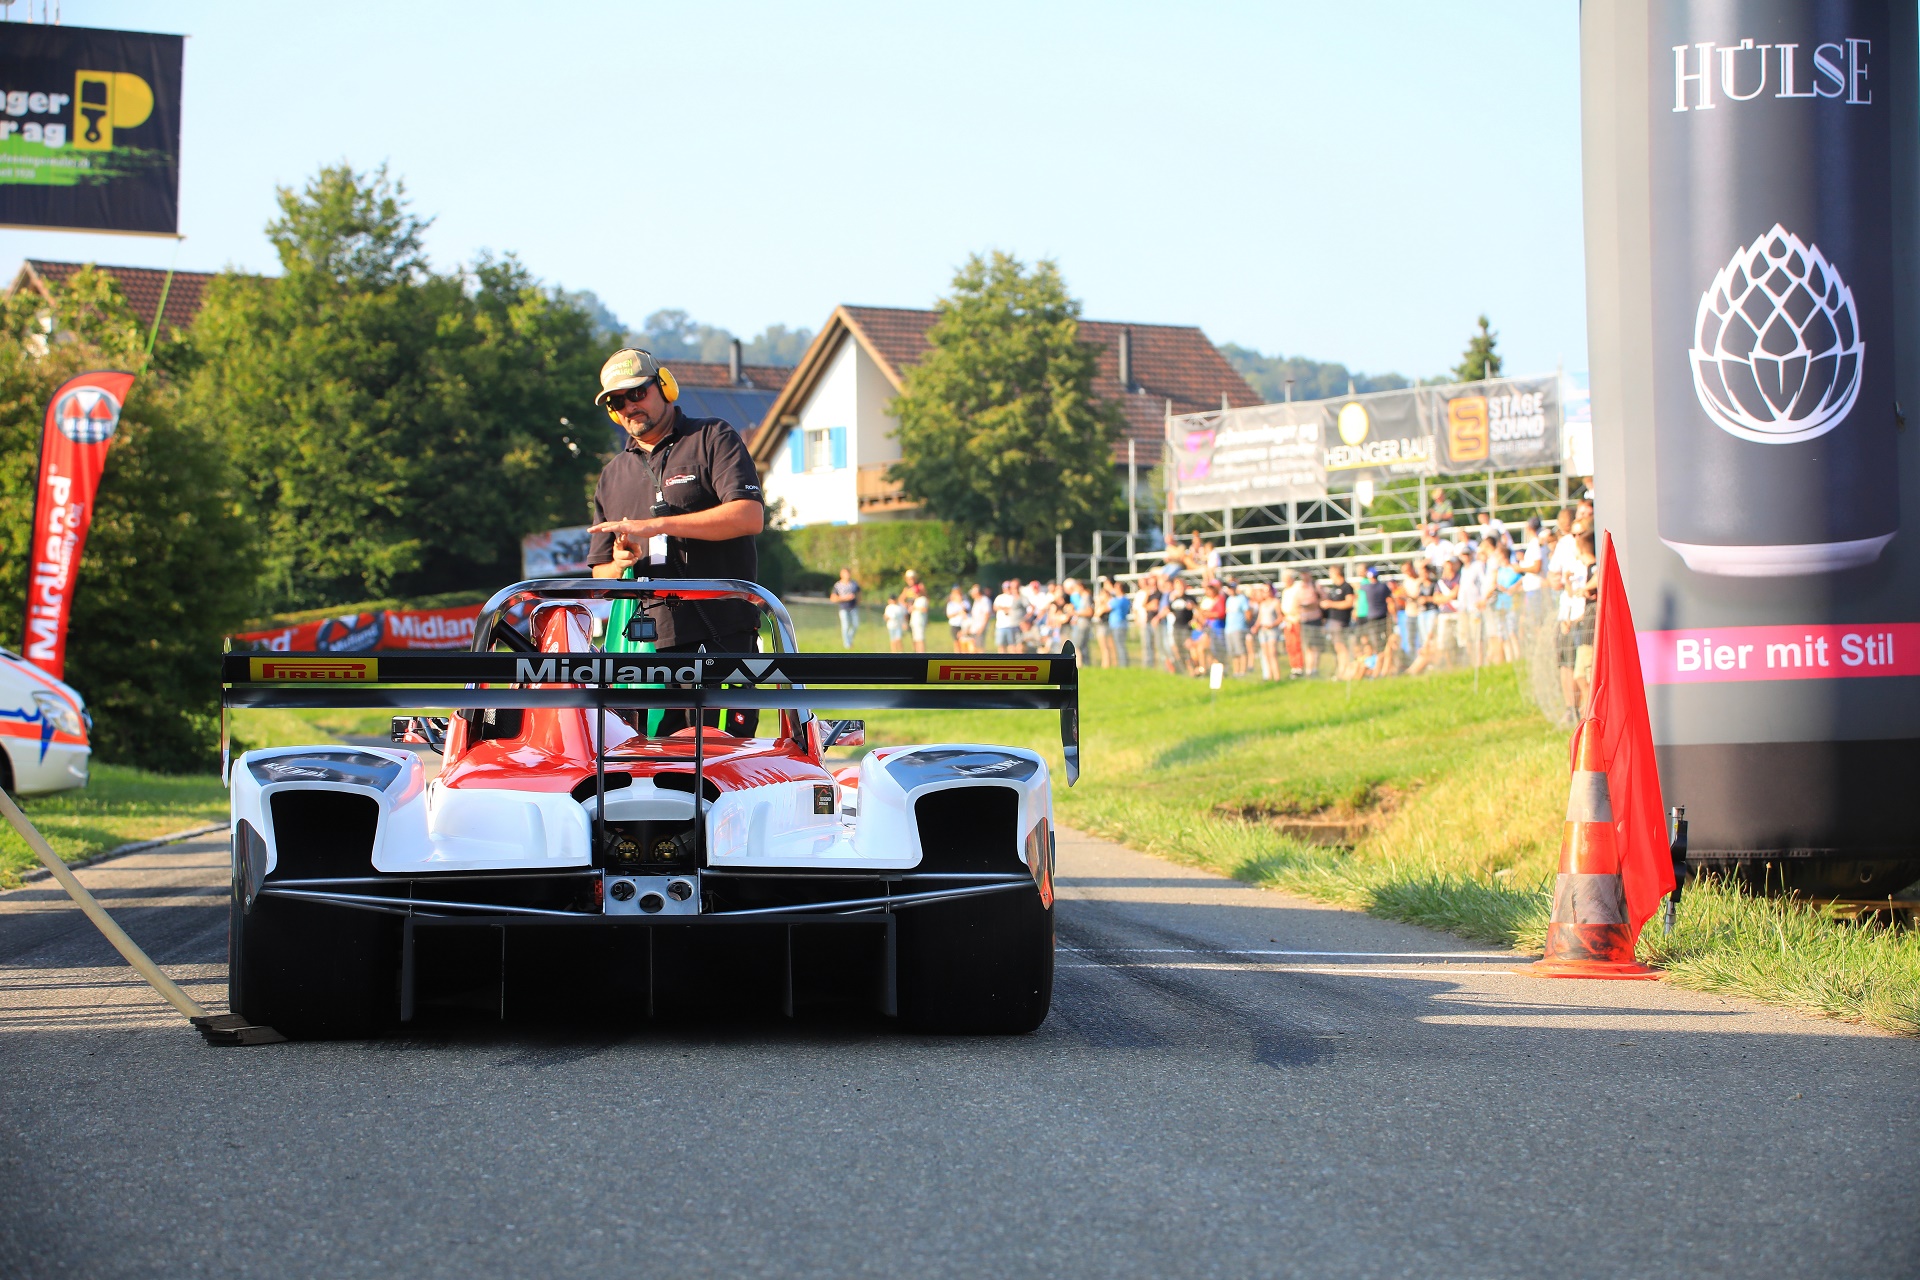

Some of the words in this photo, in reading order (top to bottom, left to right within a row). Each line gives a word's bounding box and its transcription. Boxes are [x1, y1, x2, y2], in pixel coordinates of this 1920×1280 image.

[23, 121, 67, 149] ag
[1488, 391, 1544, 419] STAGE
[1489, 414, 1545, 441] SOUND
[1323, 440, 1400, 467] HEDINGER
[389, 614, 476, 640] Midlan
[1676, 638, 1754, 672] Bier
[1766, 635, 1829, 669] mit
[1841, 633, 1894, 667] Stil
[263, 663, 367, 679] PIRELLI
[939, 665, 1039, 681] PIRELLI
